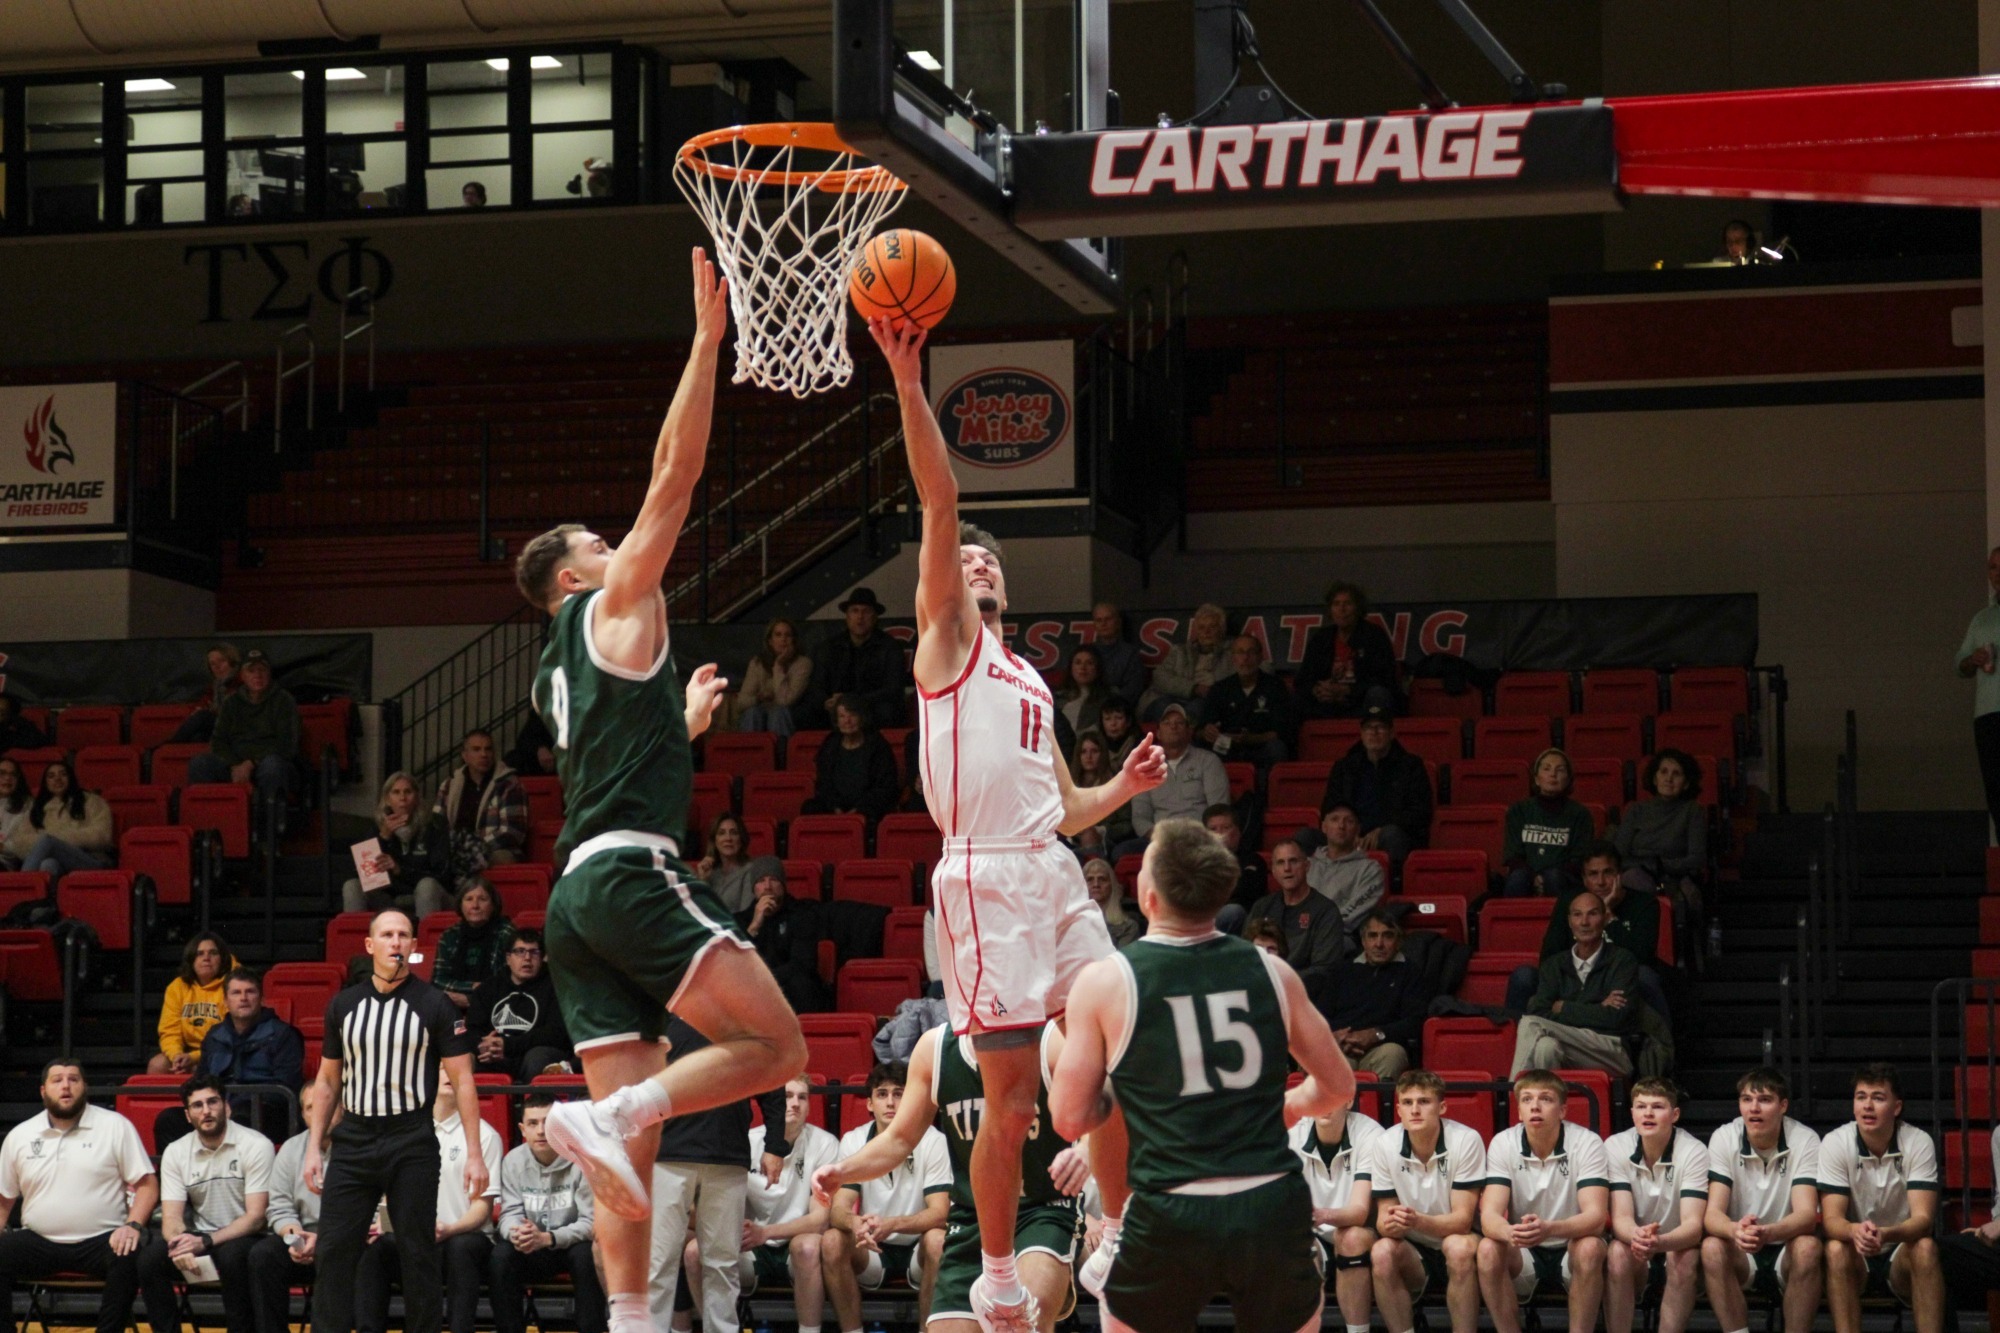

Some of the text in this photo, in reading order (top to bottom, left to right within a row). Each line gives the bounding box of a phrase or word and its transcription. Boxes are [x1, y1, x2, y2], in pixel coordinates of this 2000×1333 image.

[1090, 109, 1533, 197] CARTHAGE
[952, 387, 1053, 421] Jersey
[957, 414, 1051, 447] Mike's
[983, 447, 1021, 460] SUBS
[7, 501, 89, 517] FIREBIRDS
[1138, 609, 1470, 669] SATNG
[1020, 697, 1042, 753] 11
[1525, 830, 1567, 845] TITANS
[1162, 989, 1264, 1098] 15
[946, 1097, 1041, 1141] TITS
